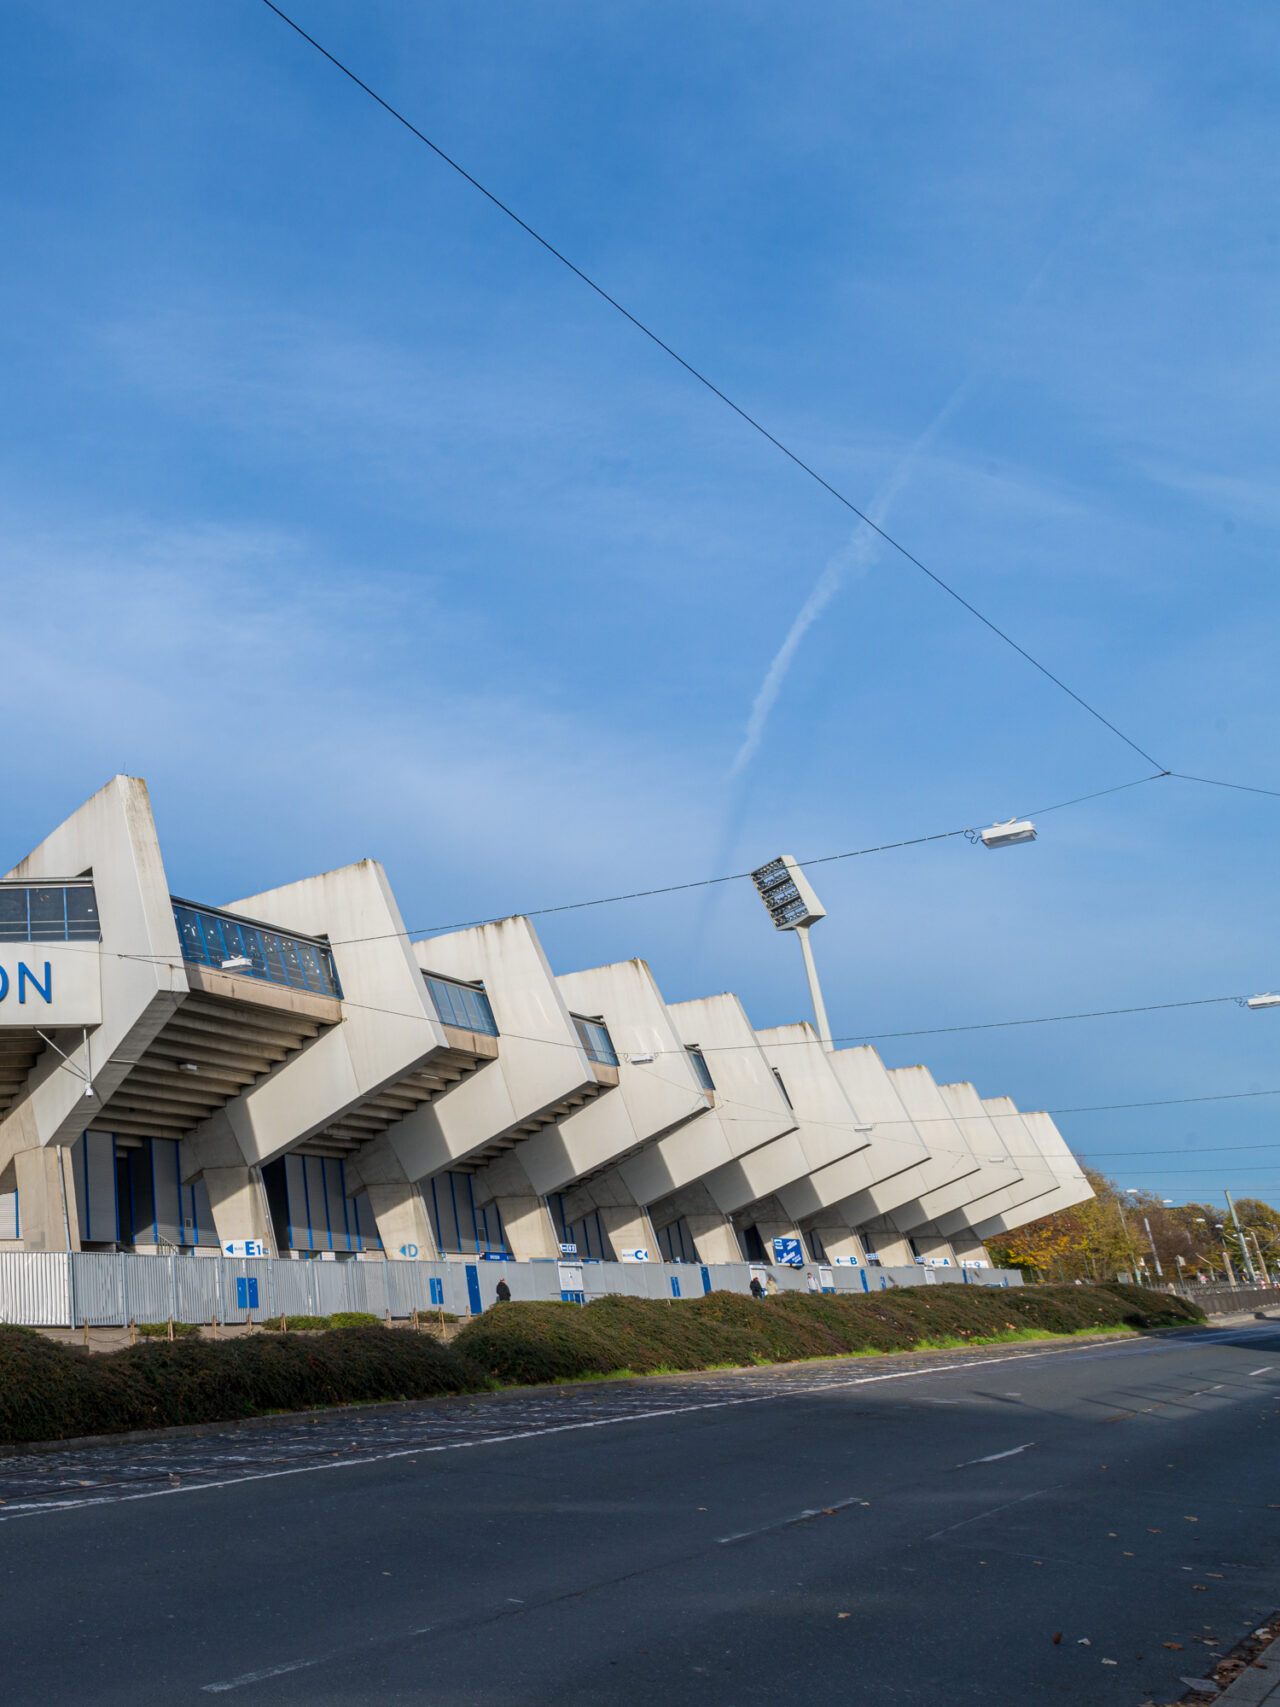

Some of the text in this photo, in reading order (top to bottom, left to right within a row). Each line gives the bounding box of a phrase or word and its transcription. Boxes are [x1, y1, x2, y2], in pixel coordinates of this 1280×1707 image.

[245, 1241, 261, 1256] E1
[408, 1244, 418, 1258] D
[634, 1250, 644, 1260] C
